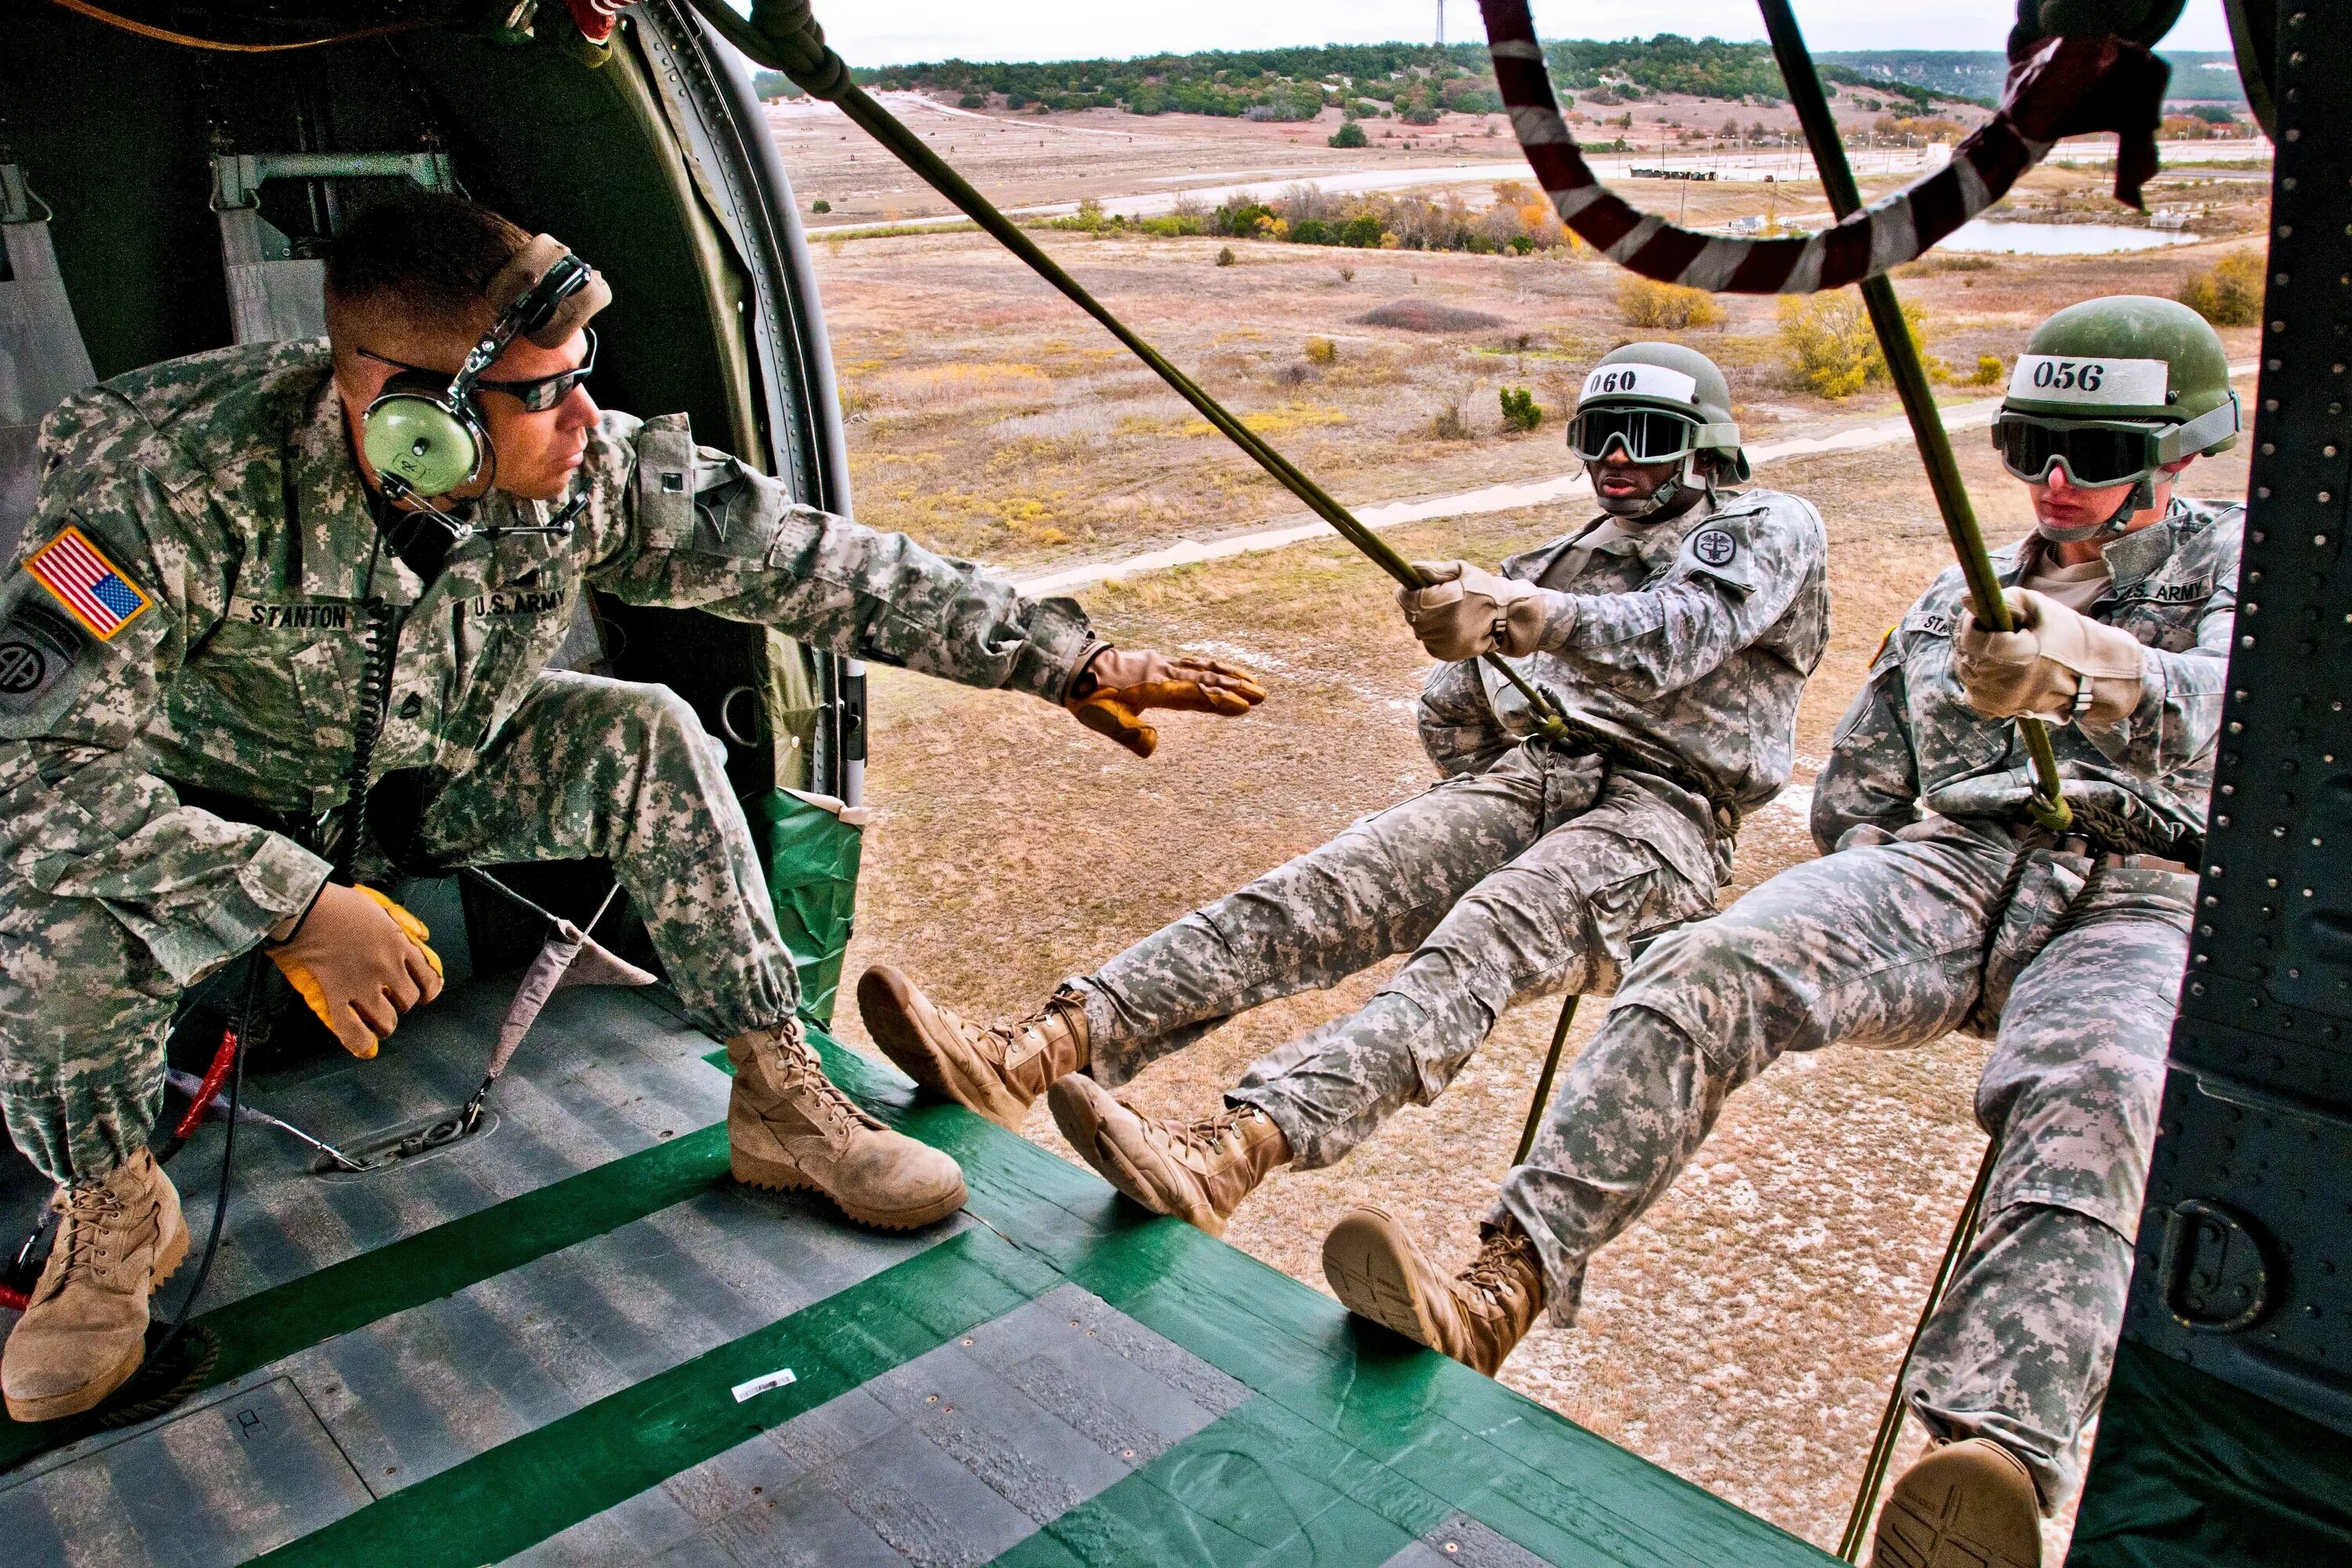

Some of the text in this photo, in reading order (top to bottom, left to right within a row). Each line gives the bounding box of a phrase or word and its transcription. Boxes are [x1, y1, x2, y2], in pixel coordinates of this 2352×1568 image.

[1590, 370, 1636, 393] 060
[2034, 361, 2104, 392] 056
[2156, 581, 2202, 601] ARMY
[249, 604, 347, 628] STANTON
